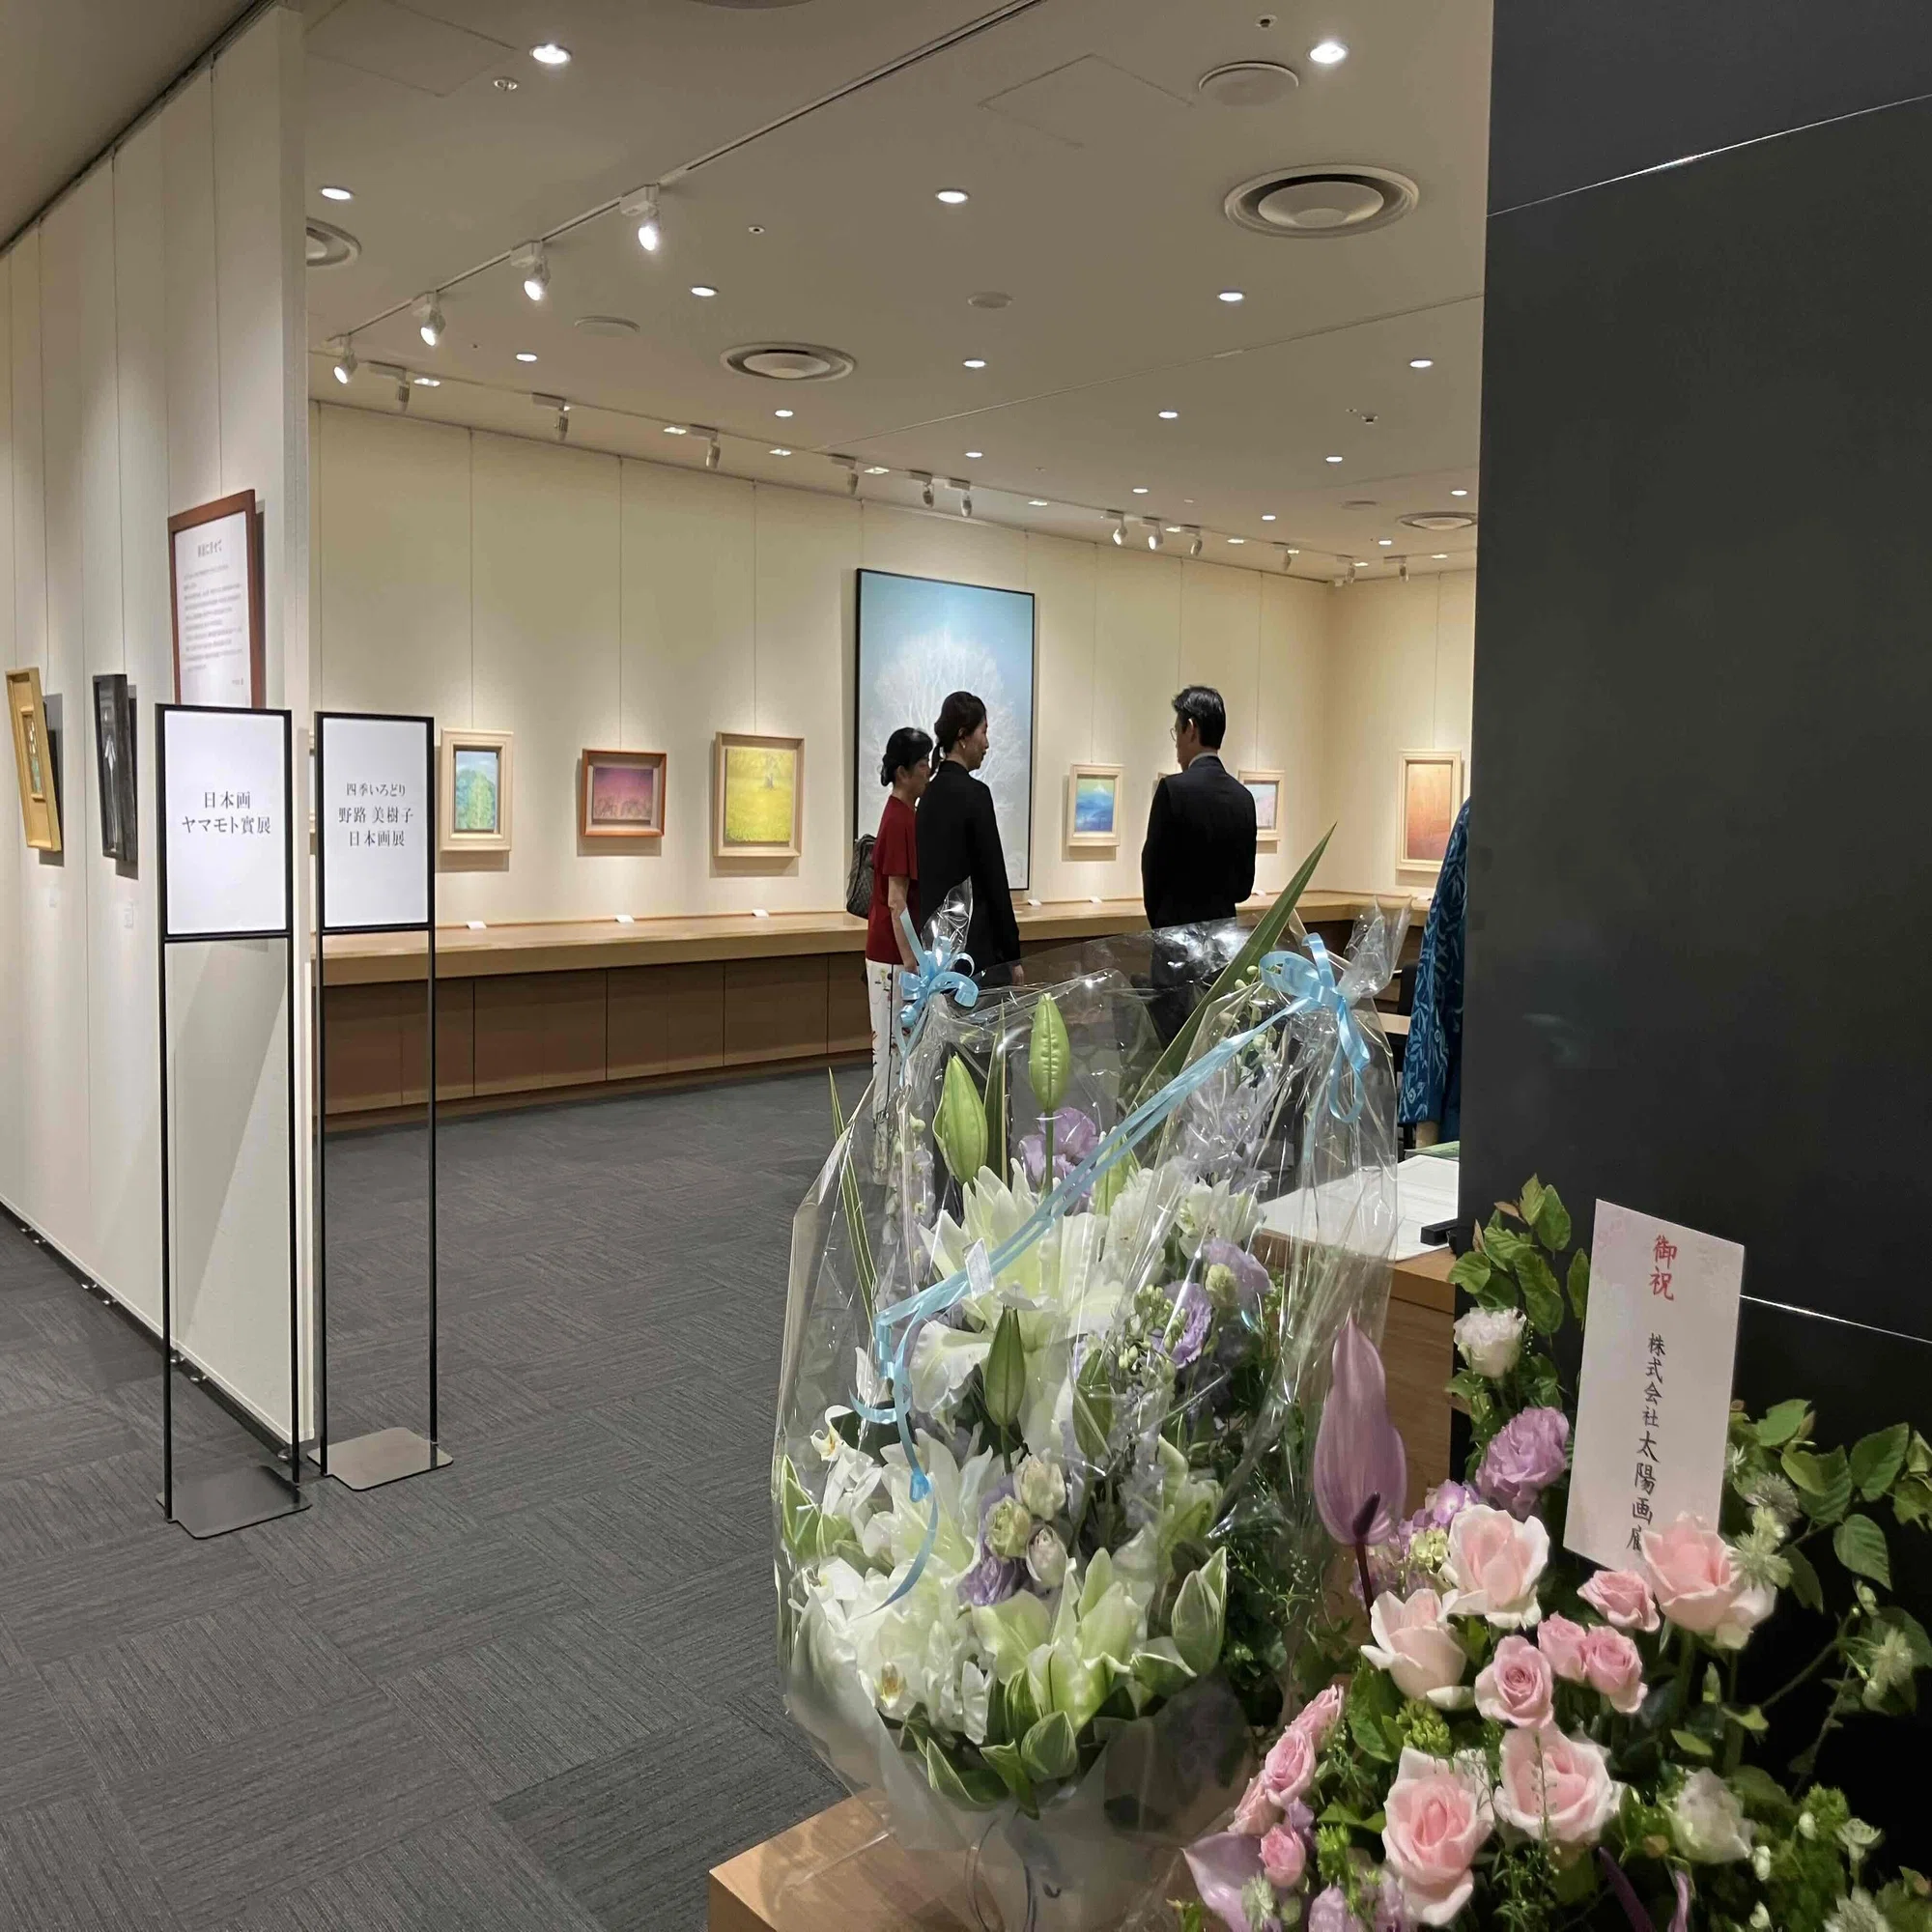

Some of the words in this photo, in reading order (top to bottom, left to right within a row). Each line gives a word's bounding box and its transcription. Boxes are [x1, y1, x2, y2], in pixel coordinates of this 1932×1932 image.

[204, 791, 251, 810] 日本画
[350, 830, 405, 847] 日本画展
[1649, 1235, 1678, 1301] 御祝
